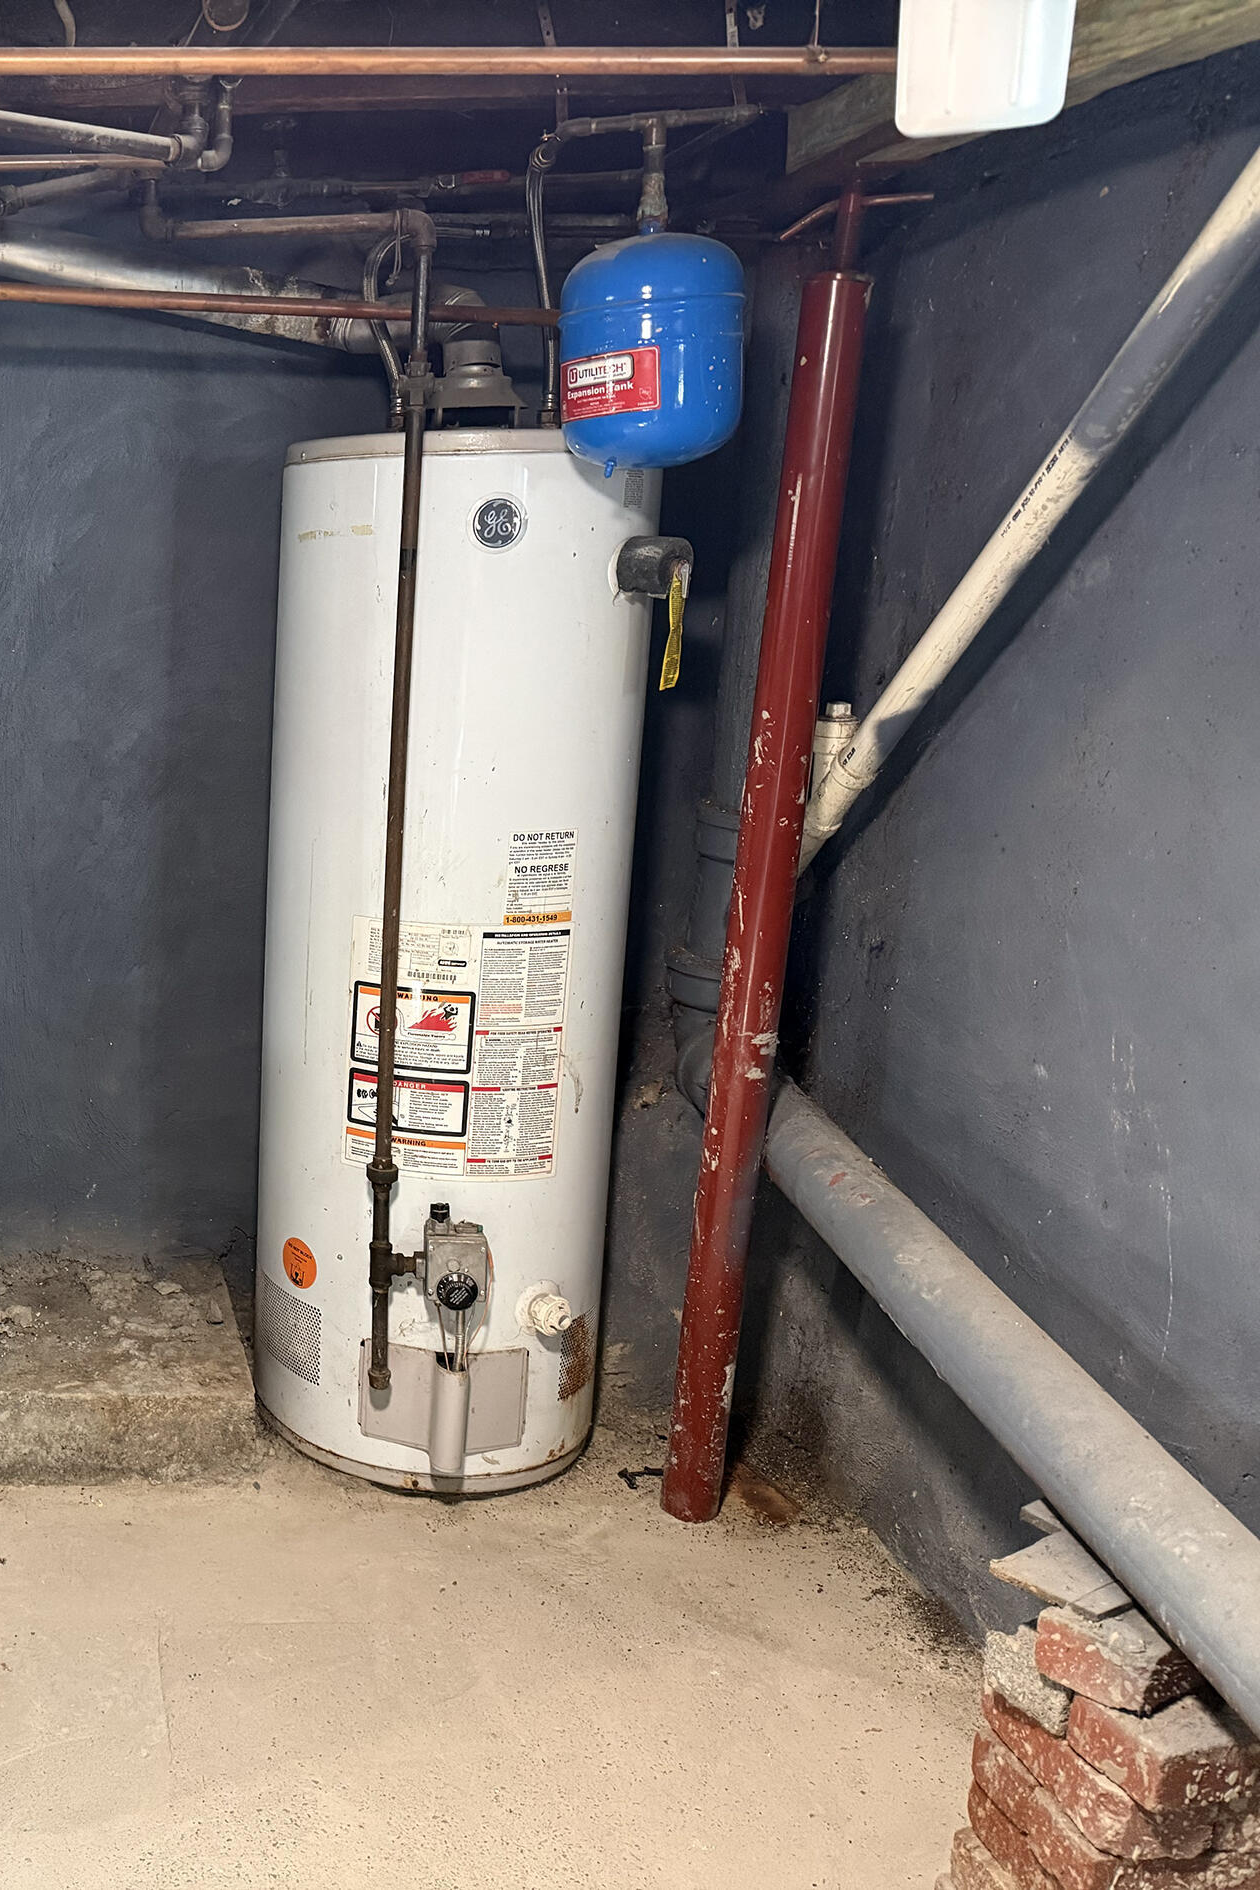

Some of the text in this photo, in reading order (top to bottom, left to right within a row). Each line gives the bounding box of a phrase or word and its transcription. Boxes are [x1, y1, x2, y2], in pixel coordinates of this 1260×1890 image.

[567, 386, 605, 400] Expansion
[483, 508, 512, 538] GE
[513, 831, 575, 842] DO NOT RETURN
[514, 863, 569, 874] NO REGRESE
[506, 914, 558, 923] 1-800-431-1549
[397, 992, 439, 1002] WAING
